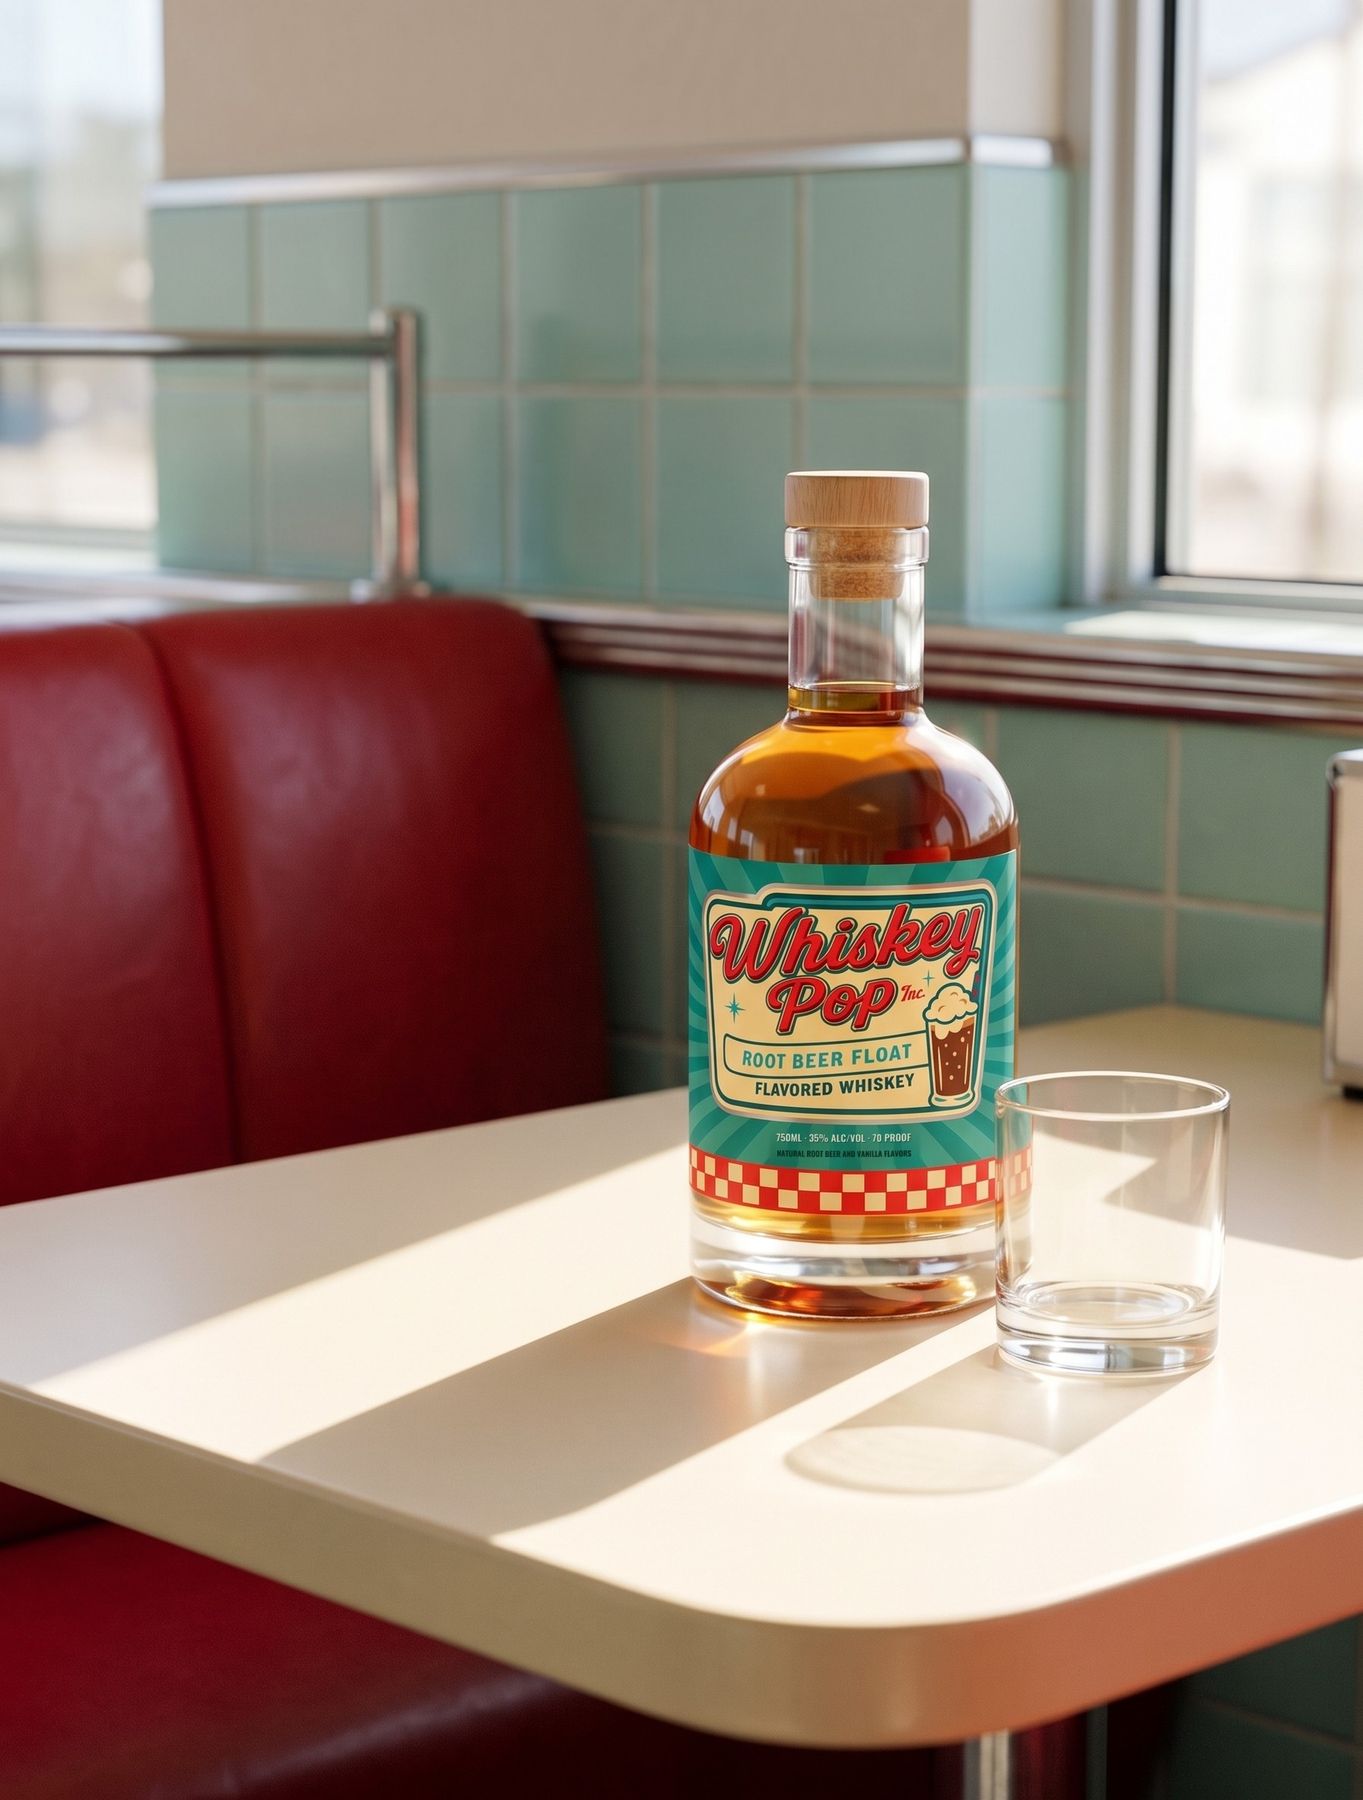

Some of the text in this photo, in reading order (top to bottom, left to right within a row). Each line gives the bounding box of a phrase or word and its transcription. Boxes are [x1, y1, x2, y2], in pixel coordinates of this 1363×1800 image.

[709, 903, 983, 983] Whiskey
[766, 976, 898, 1035] Pop
[742, 1043, 912, 1069] ROOT BEER FLOAT
[755, 1073, 915, 1097] FLAVORED WHISKEY
[776, 1133, 802, 1142] 750ML
[809, 1133, 829, 1142] 35%
[831, 1133, 866, 1143] ALC/VOL
[872, 1133, 882, 1142] 70
[884, 1133, 912, 1142] PROOF
